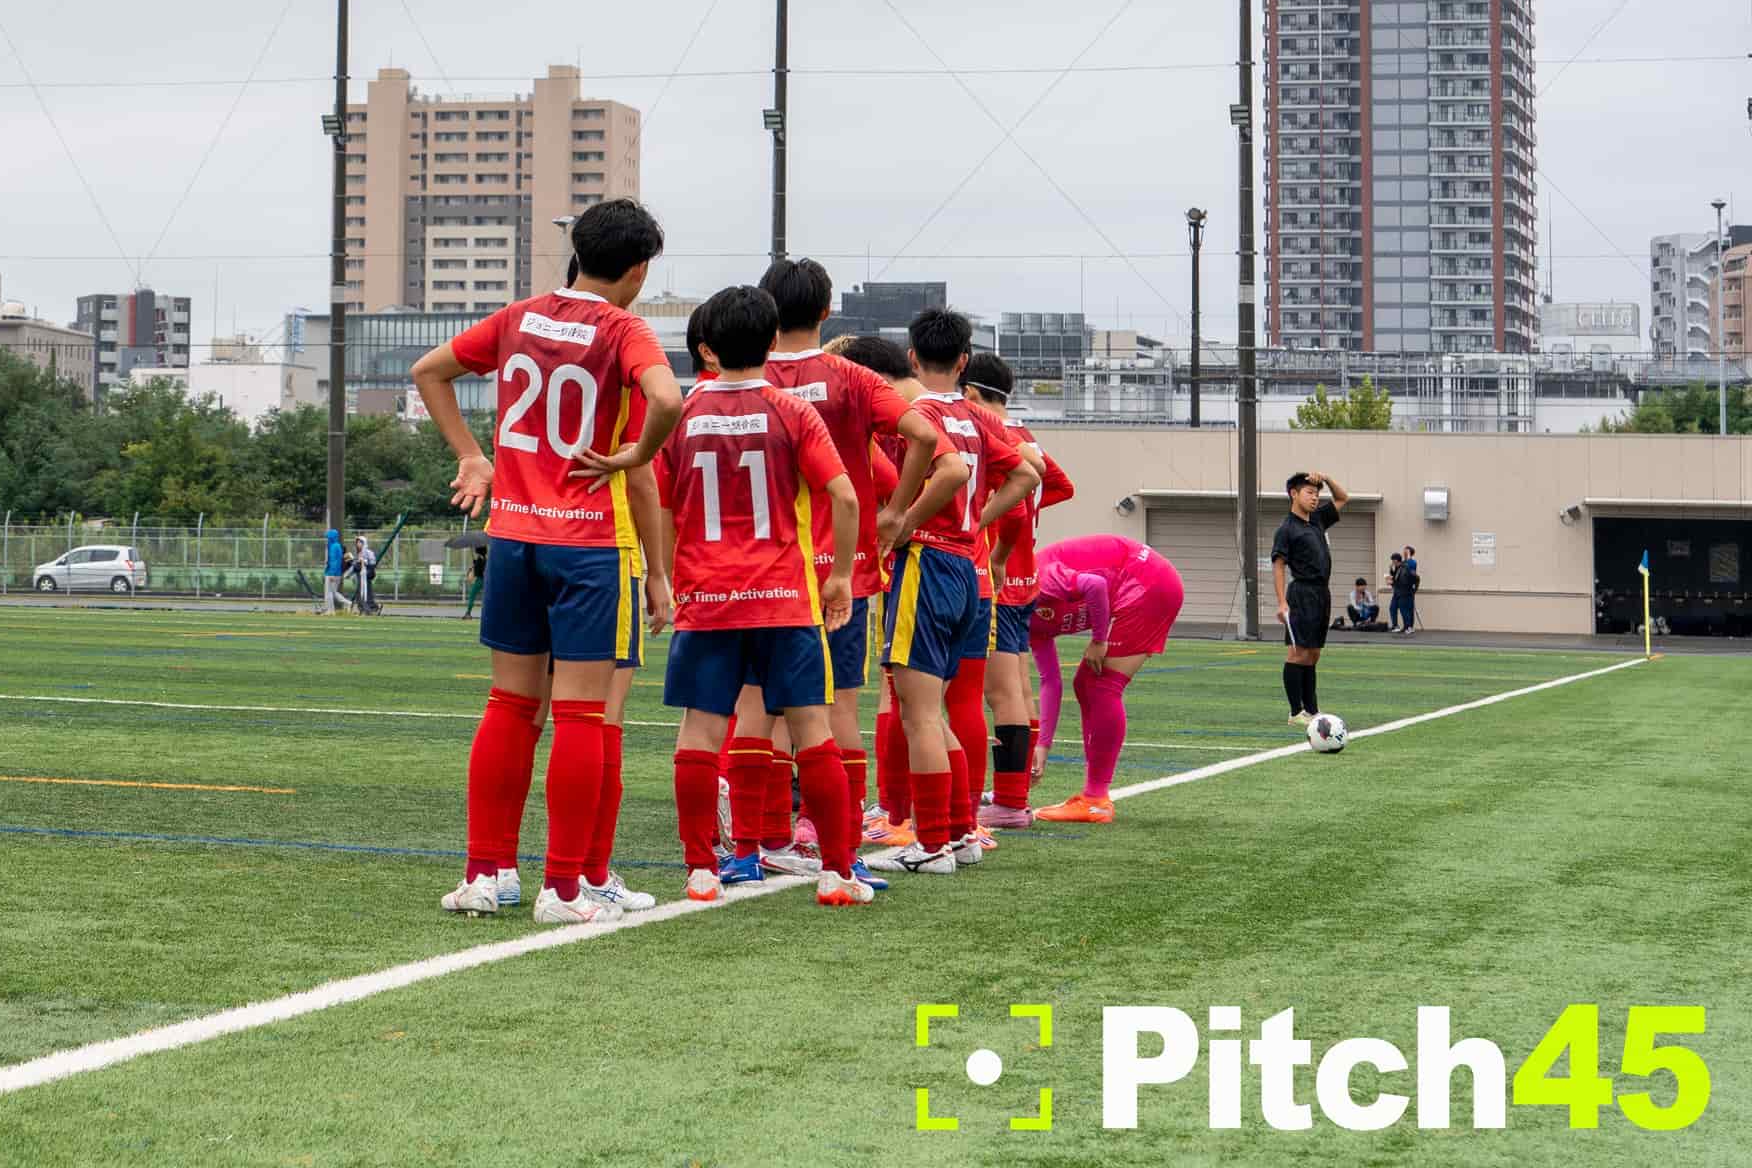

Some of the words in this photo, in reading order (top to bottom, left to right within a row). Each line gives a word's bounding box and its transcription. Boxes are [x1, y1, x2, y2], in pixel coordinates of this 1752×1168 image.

[499, 353, 598, 459] 20
[500, 498, 529, 514] Time
[530, 503, 604, 521] Activation
[692, 450, 771, 542] 11
[693, 590, 728, 603] Time
[729, 586, 799, 601] Activation
